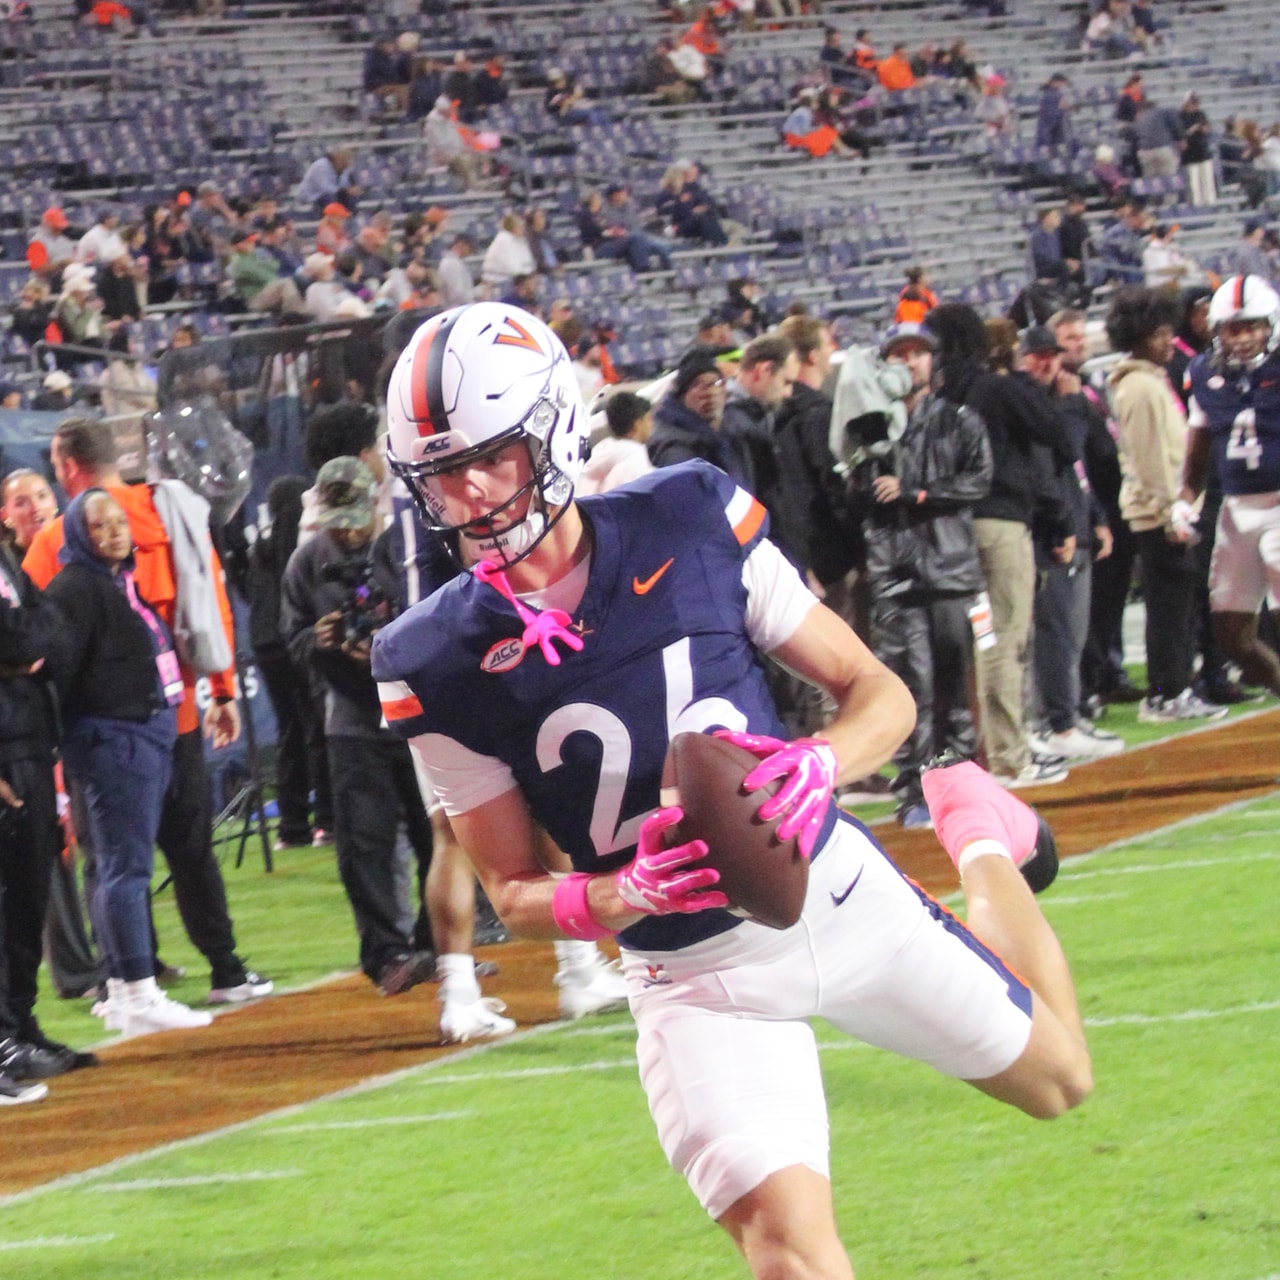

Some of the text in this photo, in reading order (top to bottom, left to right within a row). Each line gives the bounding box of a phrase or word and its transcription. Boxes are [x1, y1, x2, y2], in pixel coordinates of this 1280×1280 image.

[422, 436, 451, 455] ACC
[1226, 407, 1263, 471] 4
[489, 640, 522, 668] ACC
